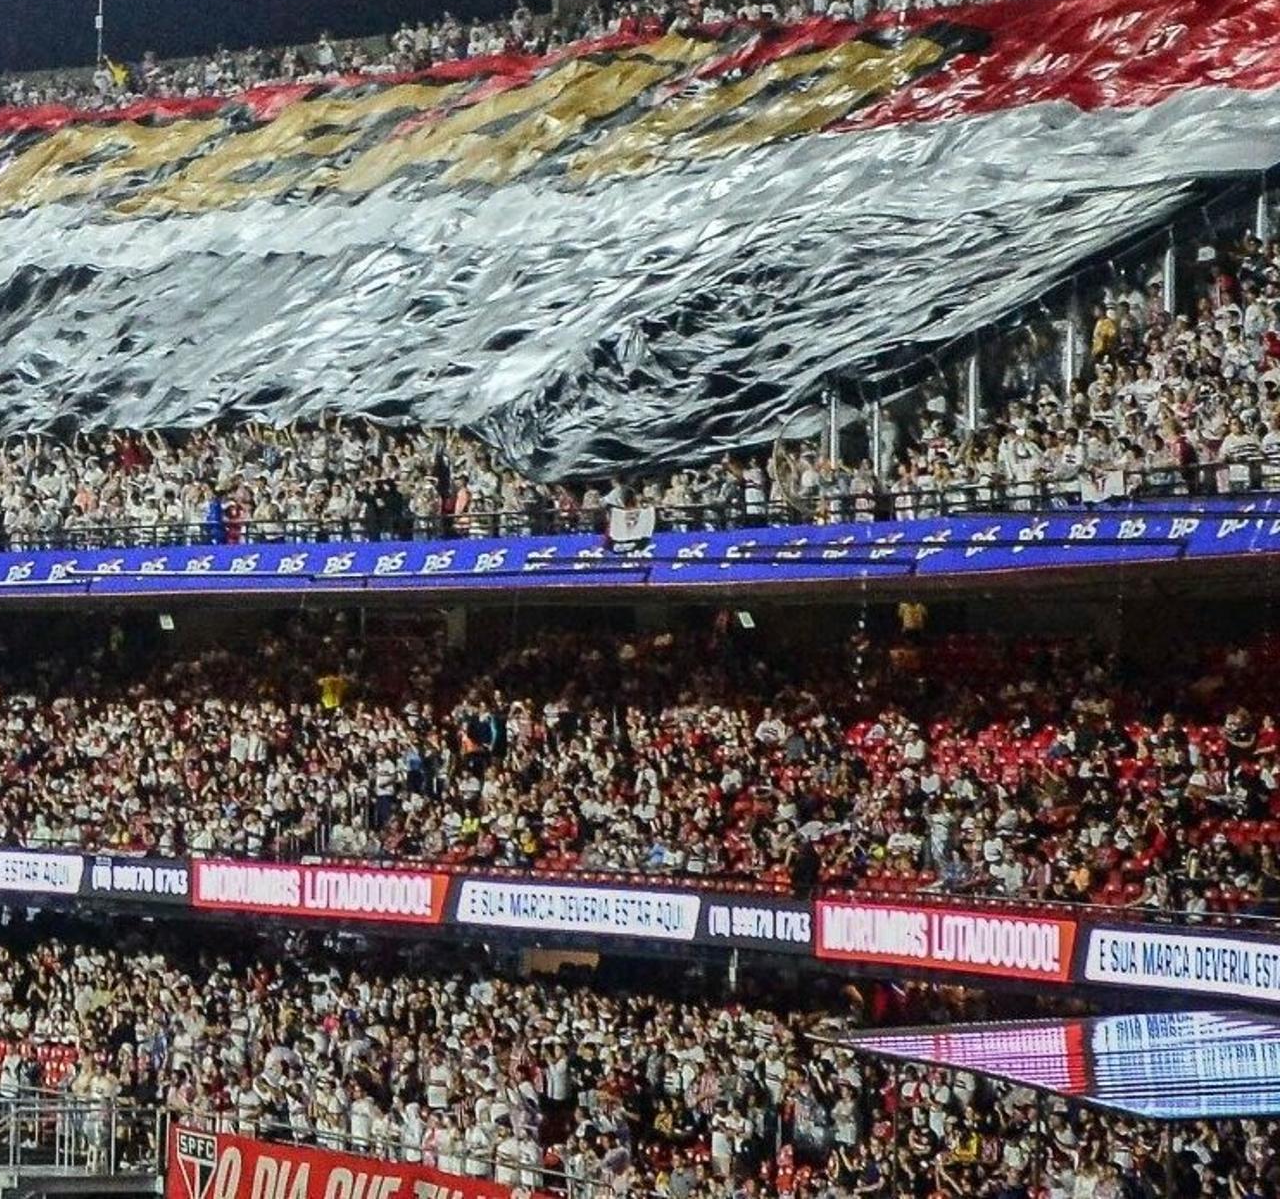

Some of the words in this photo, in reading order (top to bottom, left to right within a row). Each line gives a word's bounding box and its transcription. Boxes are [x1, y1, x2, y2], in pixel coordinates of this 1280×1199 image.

[509, 891, 555, 921] MARCA
[560, 894, 610, 924] DEVERIA
[1099, 939, 1106, 972] E
[1110, 939, 1138, 974] SUA
[1143, 941, 1191, 978] MARCA
[1195, 946, 1252, 985] DEVERIA
[1255, 952, 1280, 990] EST
[179, 1133, 215, 1161] SPFC
